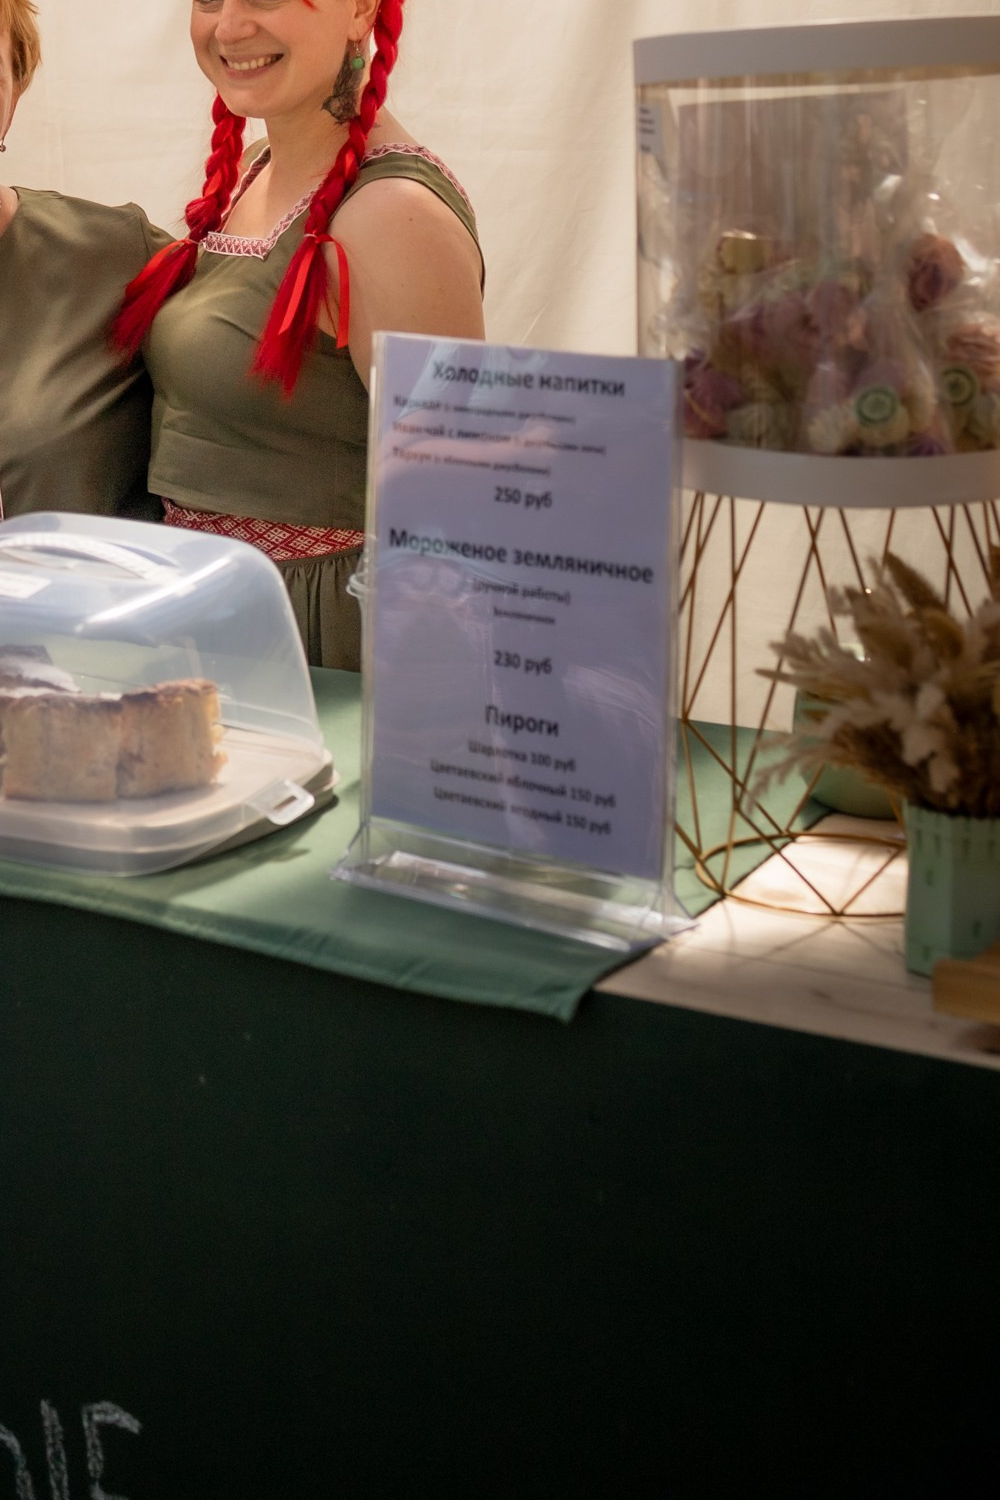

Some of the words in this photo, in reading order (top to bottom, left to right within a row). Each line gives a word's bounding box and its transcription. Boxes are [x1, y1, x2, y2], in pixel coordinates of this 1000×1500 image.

[431, 359, 535, 390] Холодные
[538, 369, 626, 397] напитки
[493, 485, 521, 504] 250
[524, 489, 552, 510] руб
[388, 526, 508, 564] Мороженое
[512, 546, 654, 584] земляничное
[493, 650, 521, 670] 230
[524, 655, 552, 676] руб
[484, 704, 560, 738] Пироги
[554, 757, 577, 773] руб
[594, 792, 617, 809] руб
[589, 819, 612, 835] руб
